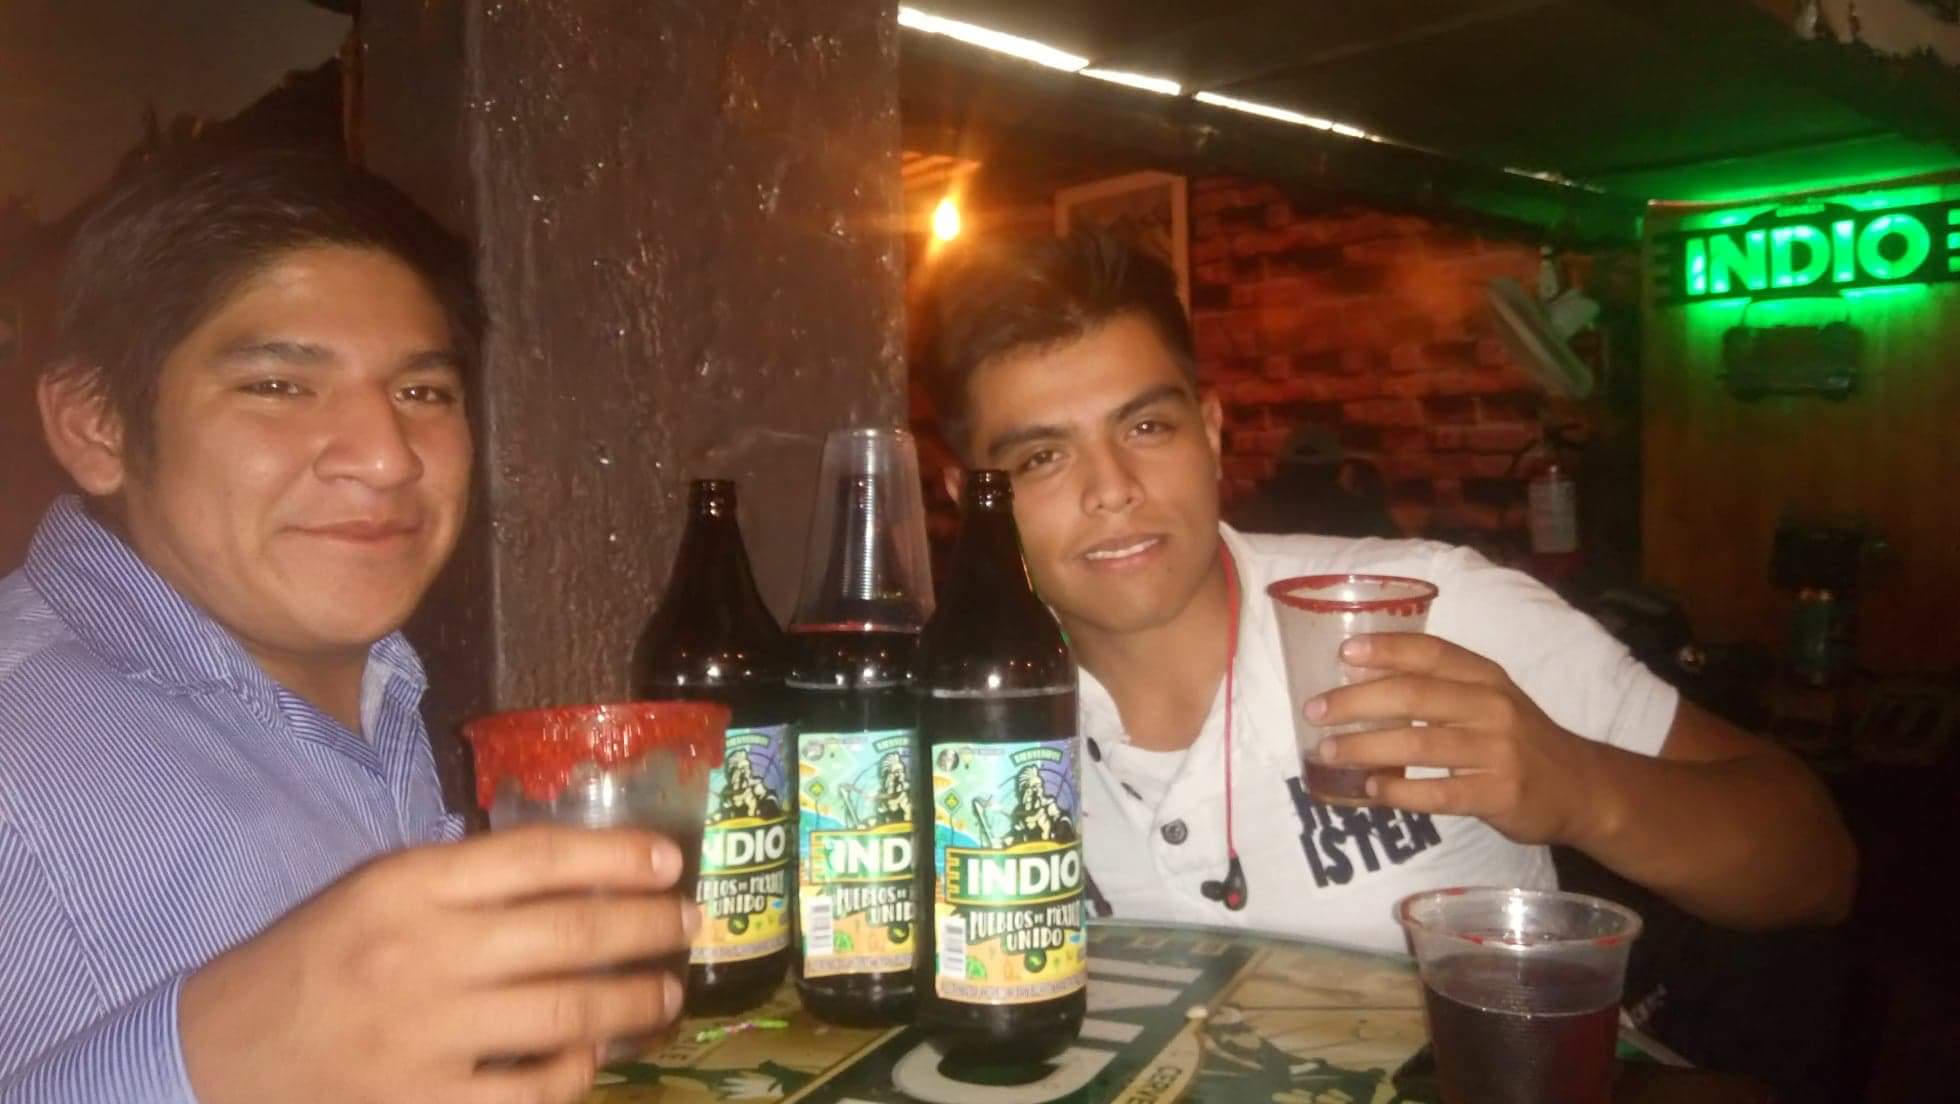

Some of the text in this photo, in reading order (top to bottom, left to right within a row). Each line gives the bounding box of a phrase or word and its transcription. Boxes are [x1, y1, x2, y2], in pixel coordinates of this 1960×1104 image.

[1686, 213, 1931, 296] INDIO
[702, 825, 785, 867] NDIO
[832, 836, 912, 874] IND
[967, 850, 1080, 896] INDIO
[871, 900, 917, 924] UNID
[970, 909, 1033, 941] PUEBLOS
[1006, 927, 1063, 951] UNIDO
